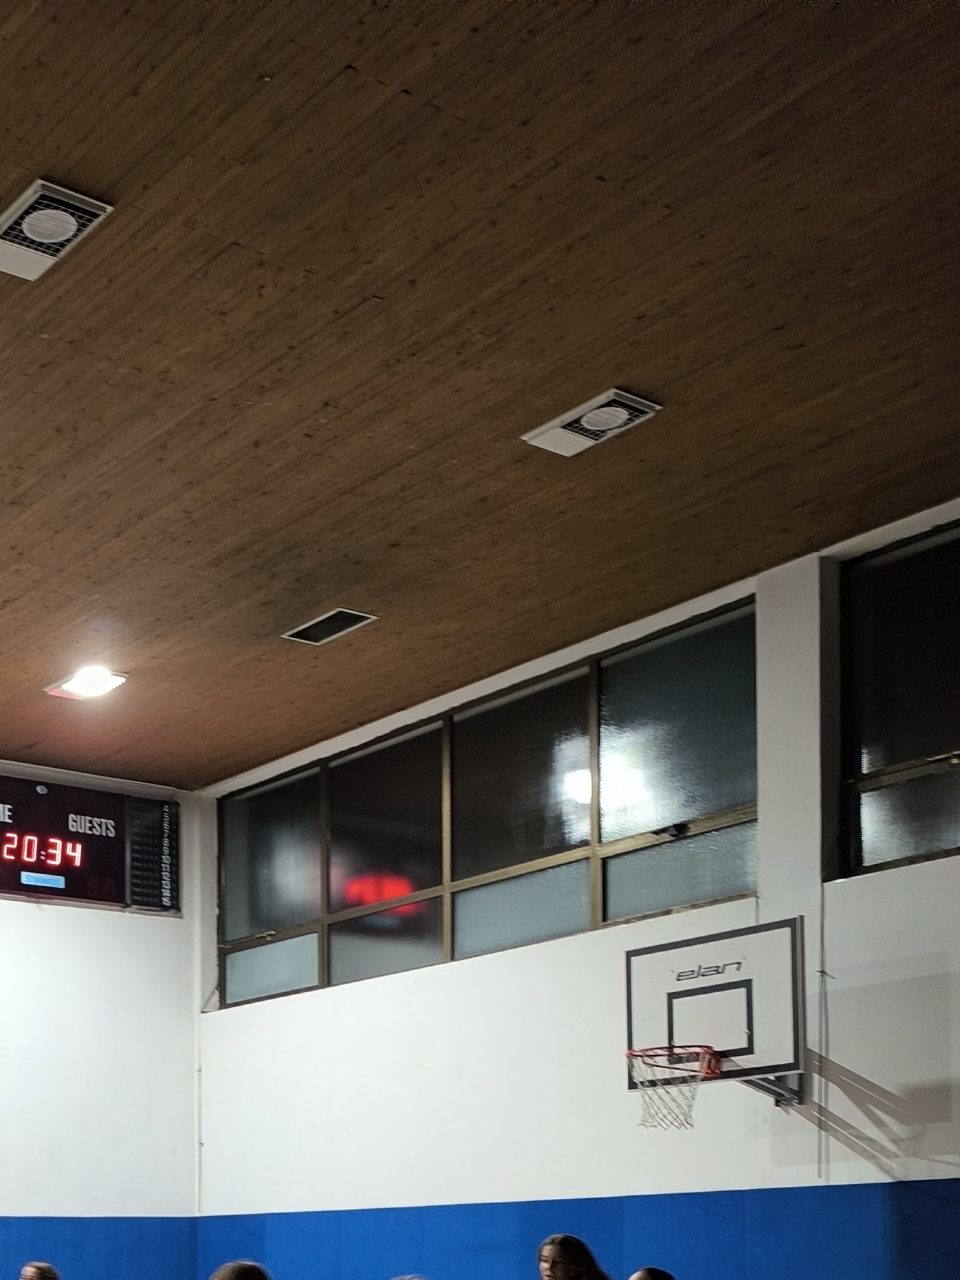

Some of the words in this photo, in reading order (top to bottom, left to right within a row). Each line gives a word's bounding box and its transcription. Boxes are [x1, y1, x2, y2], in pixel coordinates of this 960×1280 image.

[68, 813, 116, 837] GUESTS
[3, 833, 82, 867] 20:34
[676, 961, 742, 981] elan
